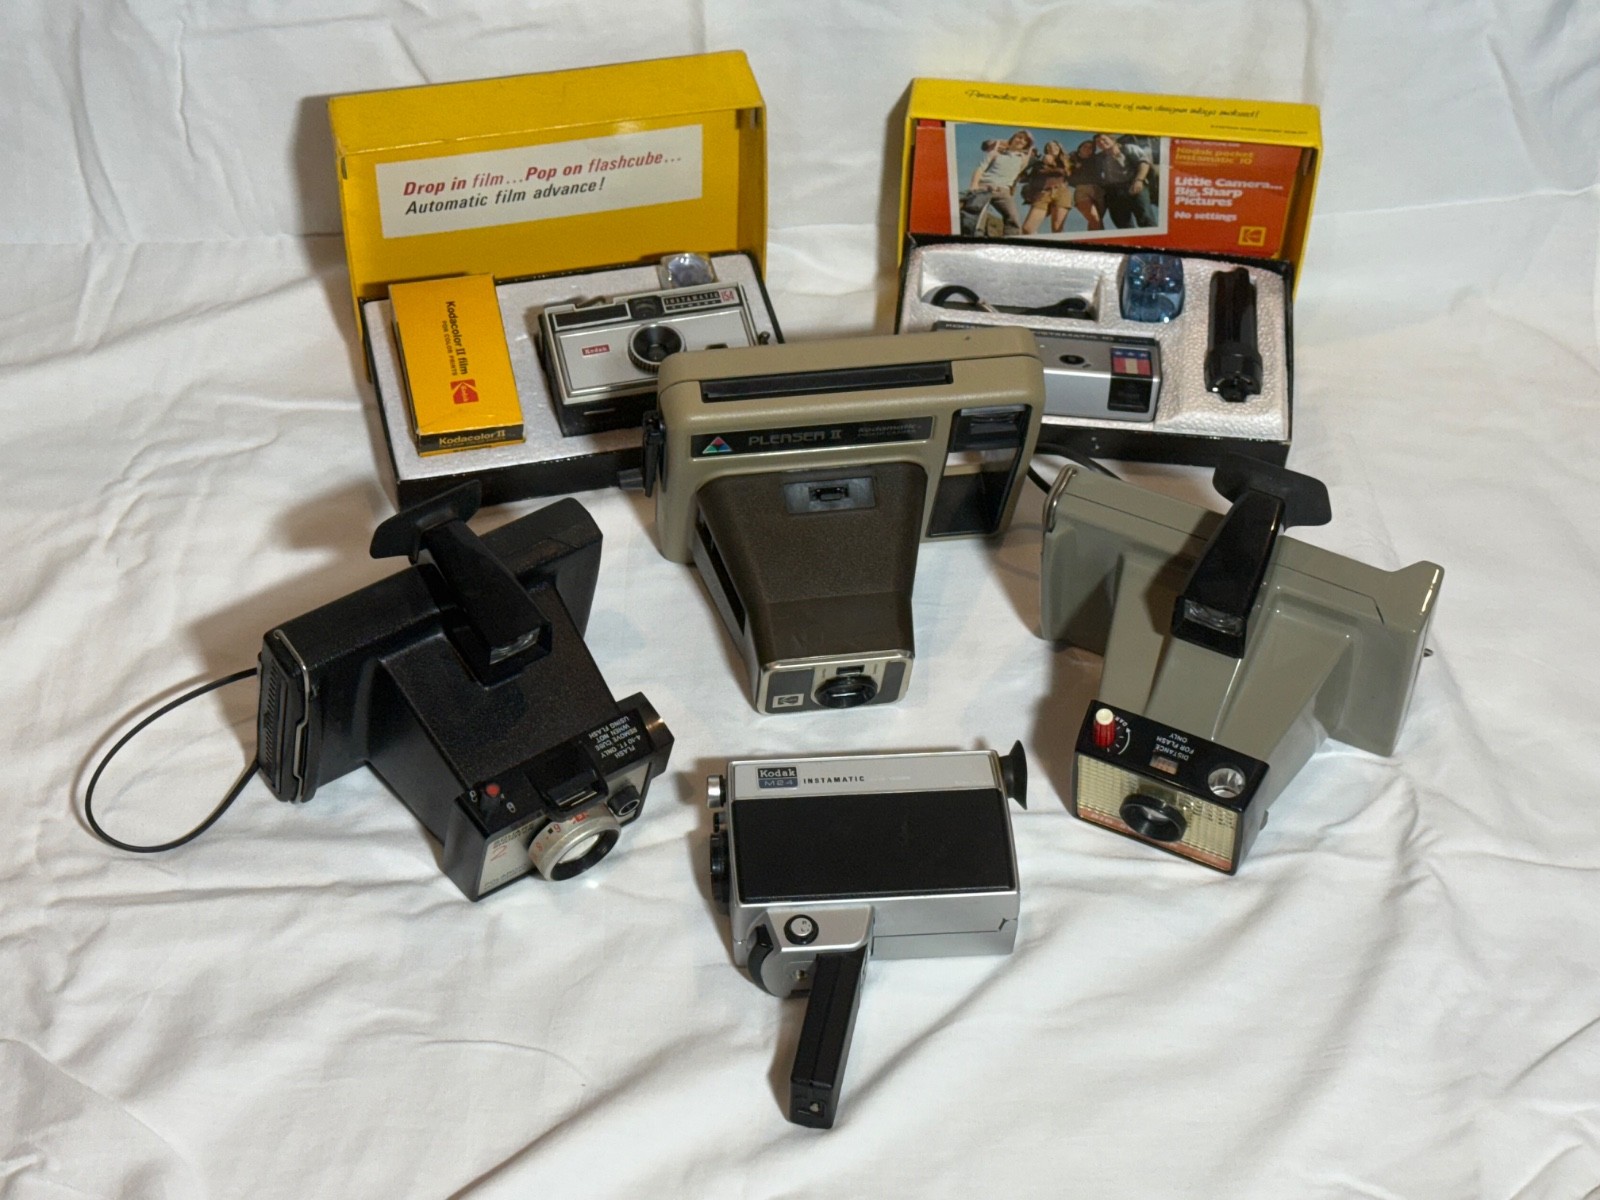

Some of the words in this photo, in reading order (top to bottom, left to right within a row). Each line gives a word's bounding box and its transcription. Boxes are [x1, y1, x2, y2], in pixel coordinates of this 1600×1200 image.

[403, 181, 445, 196] Drop
[450, 176, 467, 191] in
[562, 164, 583, 177] on
[588, 151, 682, 173] flashcube...
[1174, 176, 1213, 187] Little
[405, 192, 488, 215] Automatic
[494, 189, 526, 205] film
[532, 176, 606, 199] advance!
[1202, 187, 1244, 199] Sharp
[1174, 196, 1233, 207] Pictures
[1174, 211, 1192, 219] No
[1194, 212, 1238, 223] settings
[445, 300, 462, 347] Kodacolor
[455, 347, 467, 356] II
[458, 355, 469, 375] film
[439, 432, 494, 446] Kodacolor
[496, 429, 506, 438] II
[748, 430, 826, 446] PLEASER
[830, 428, 844, 439] II
[609, 715, 630, 729] USING
[588, 725, 610, 740] FLASH
[610, 723, 631, 736] WHEN
[611, 726, 638, 743] REMOVE
[596, 733, 610, 744] NOT
[1156, 736, 1180, 749] FLASH
[1169, 733, 1188, 744] ONLY
[594, 739, 613, 752] CUBE
[614, 745, 636, 759] FLASH
[1179, 745, 1195, 755] FOR
[600, 746, 617, 759] ONLY
[1154, 743, 1189, 762] DISTANCE
[759, 768, 796, 778] Kodak
[764, 779, 793, 787] M24
[803, 775, 865, 785] INSTAMATIC
